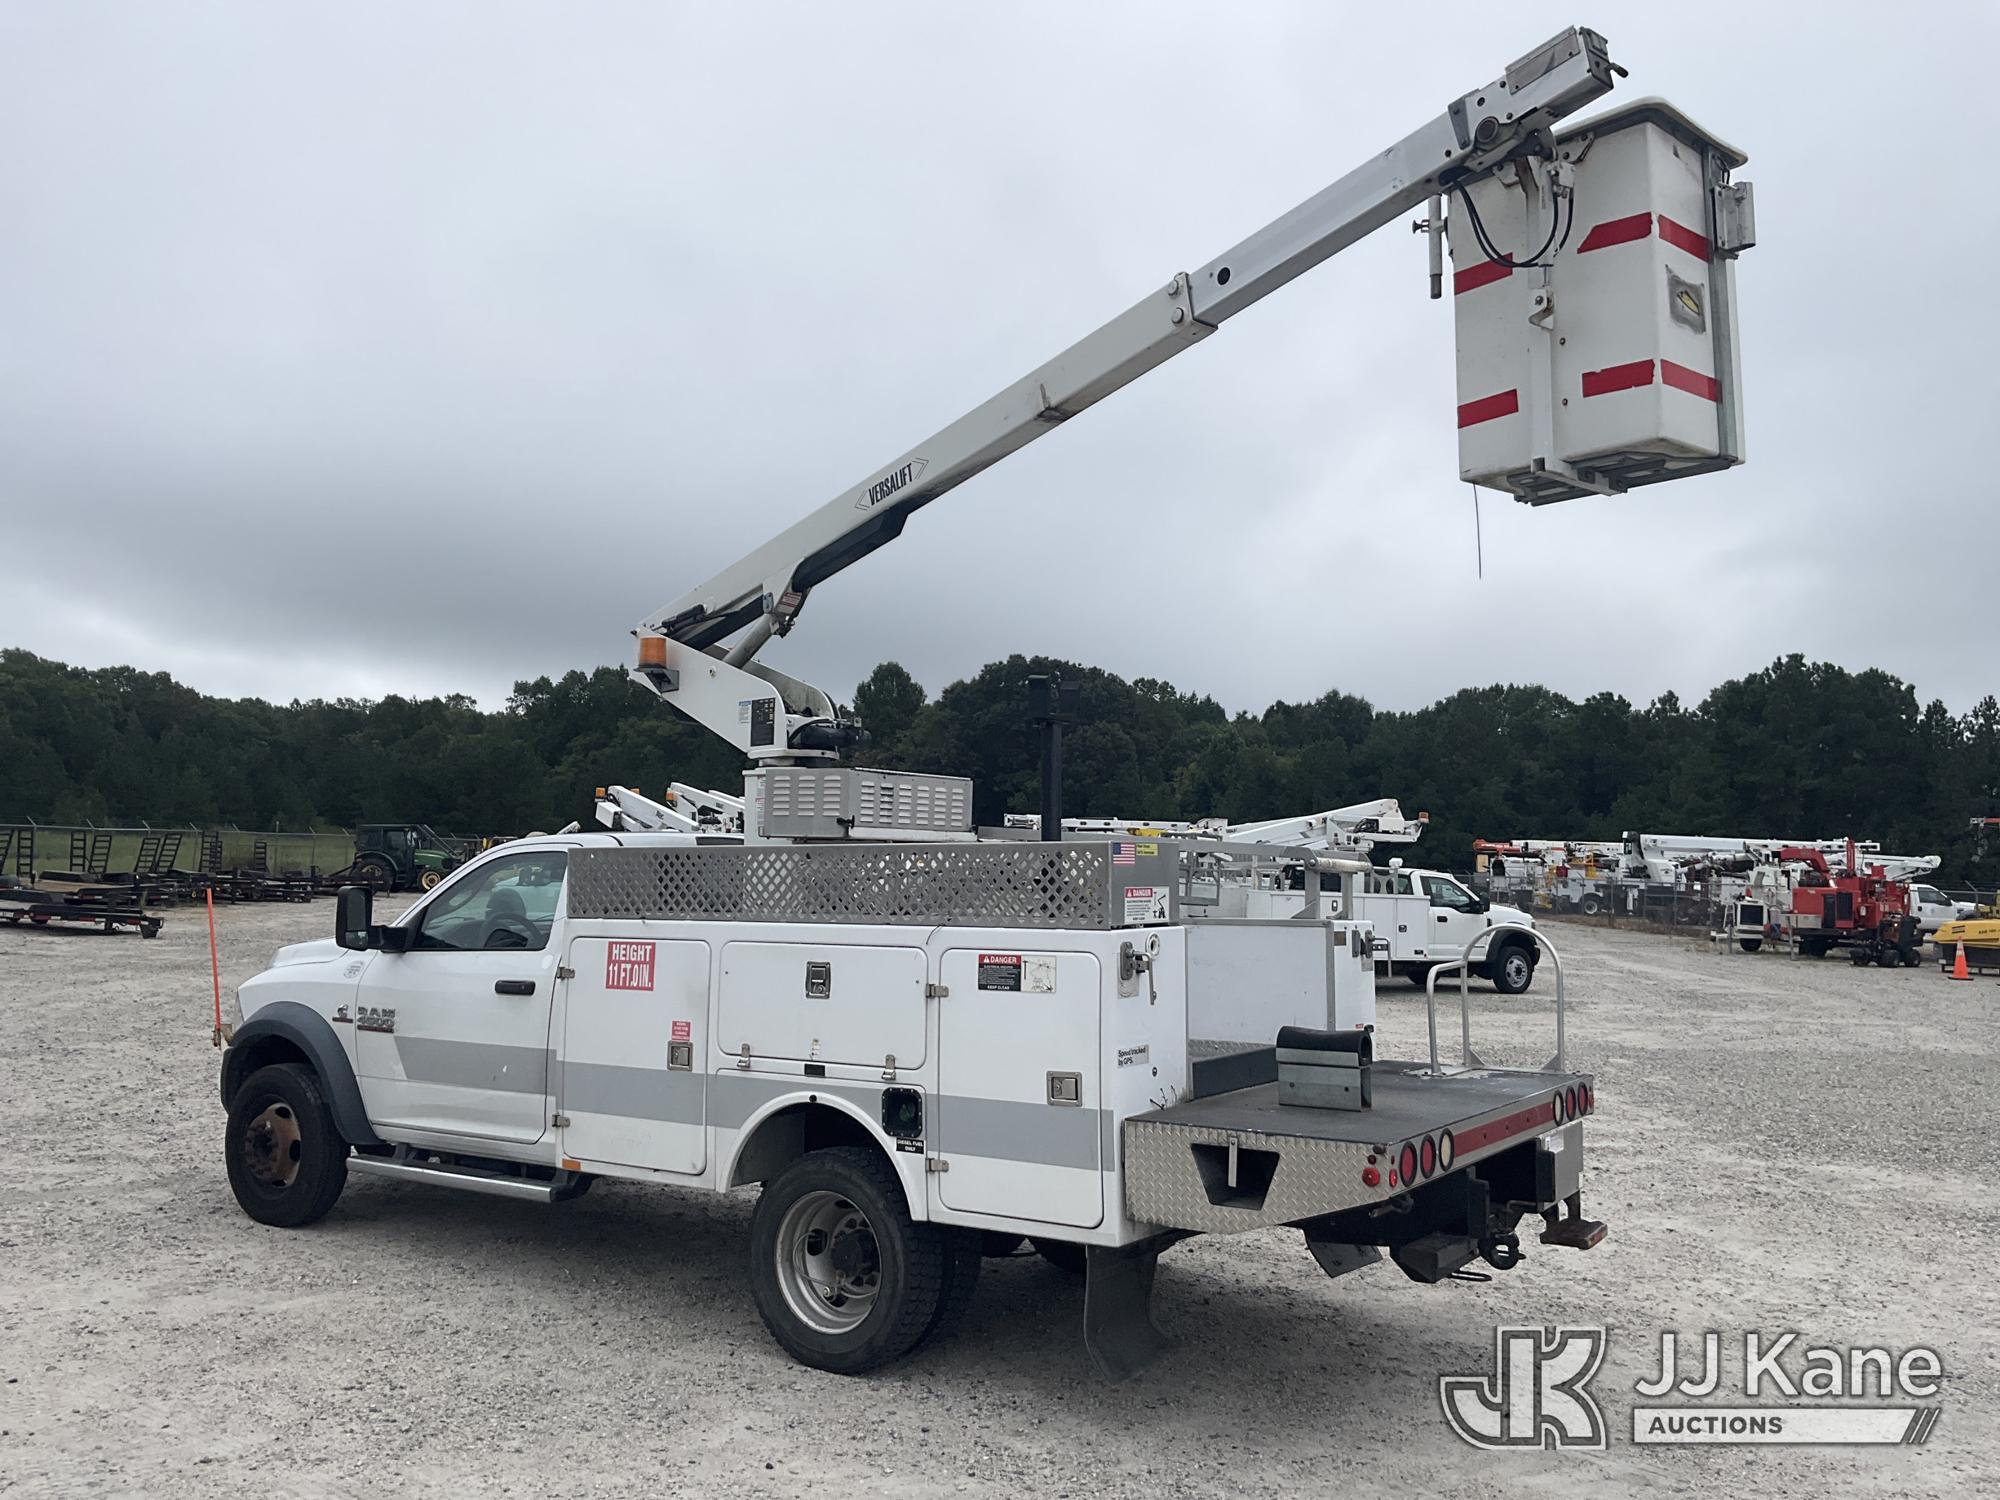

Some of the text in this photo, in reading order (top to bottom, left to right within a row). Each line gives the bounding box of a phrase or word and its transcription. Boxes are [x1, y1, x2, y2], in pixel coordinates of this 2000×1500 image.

[868, 462, 913, 506] VERSALIFT
[1133, 889, 1152, 897] DANGER
[612, 944, 652, 961] HEIGHT
[990, 956, 1017, 964] DANGER
[609, 963, 618, 986] 11
[358, 1006, 396, 1019] RAM
